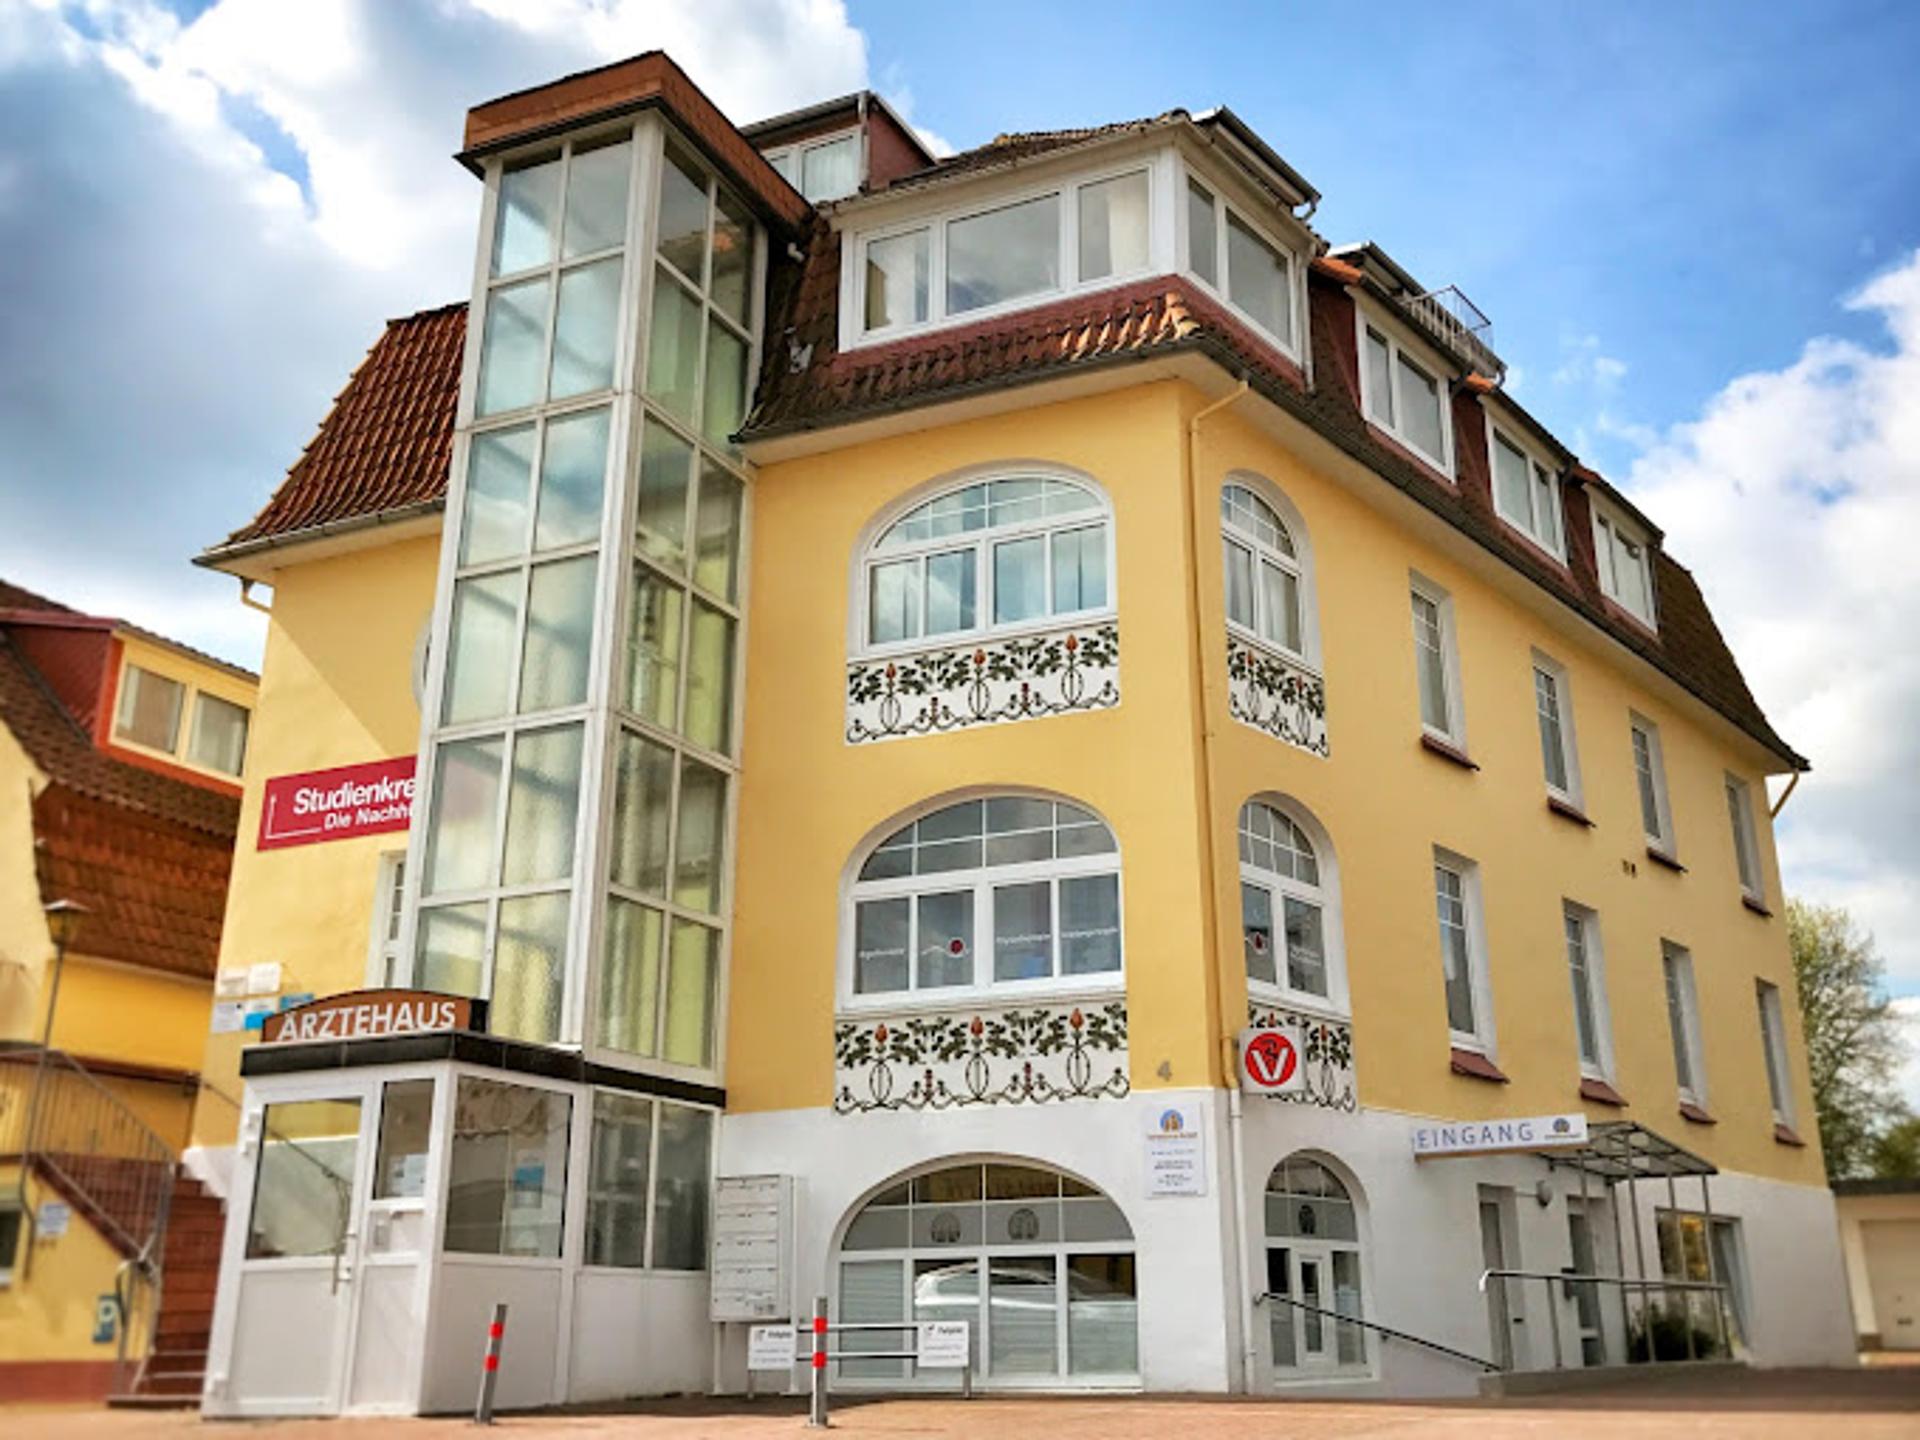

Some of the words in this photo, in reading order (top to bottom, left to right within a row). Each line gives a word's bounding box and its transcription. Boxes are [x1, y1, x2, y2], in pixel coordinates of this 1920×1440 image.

[324, 812, 351, 830] Die
[356, 801, 414, 825] Nachh
[277, 1001, 456, 1041] ÄRZTEHAUS
[1157, 1060, 1172, 1081] 4
[1416, 1122, 1534, 1149] EINGANG
